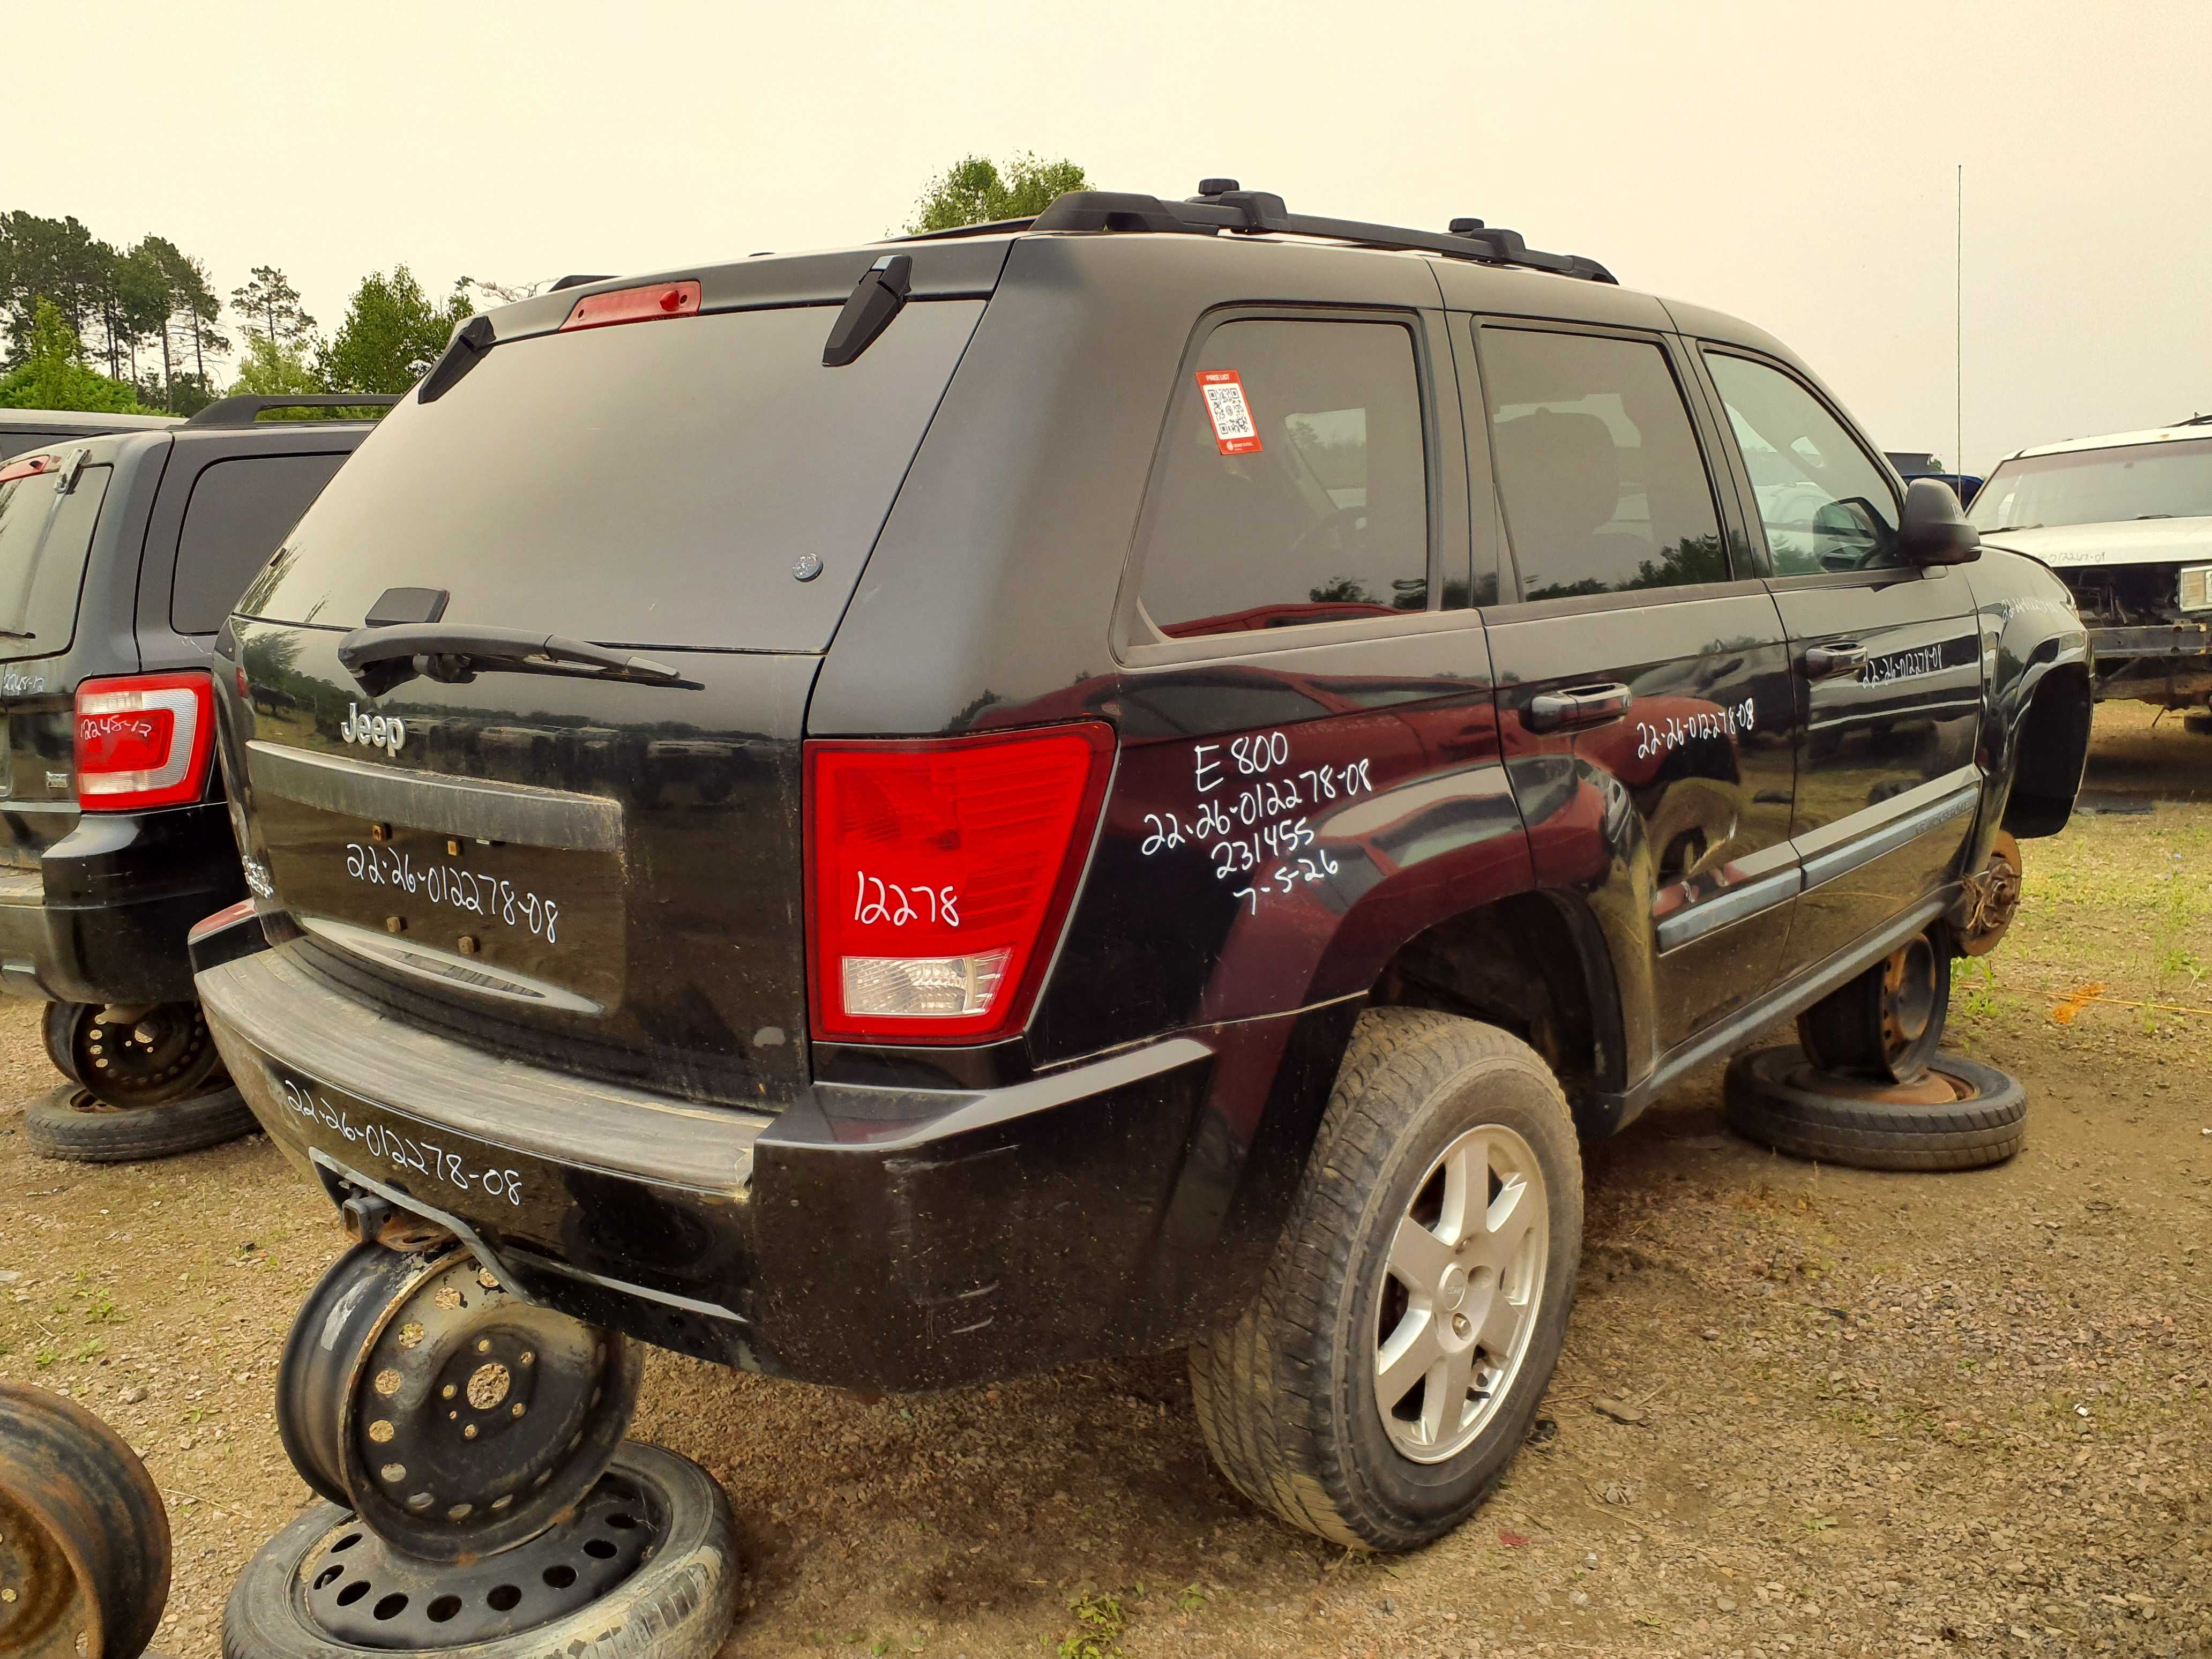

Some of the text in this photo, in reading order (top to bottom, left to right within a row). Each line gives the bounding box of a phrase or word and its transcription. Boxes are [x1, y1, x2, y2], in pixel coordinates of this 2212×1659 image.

[340, 703, 406, 758] Jeep
[1194, 731, 1288, 792] E 800
[854, 871, 960, 926] 12278
